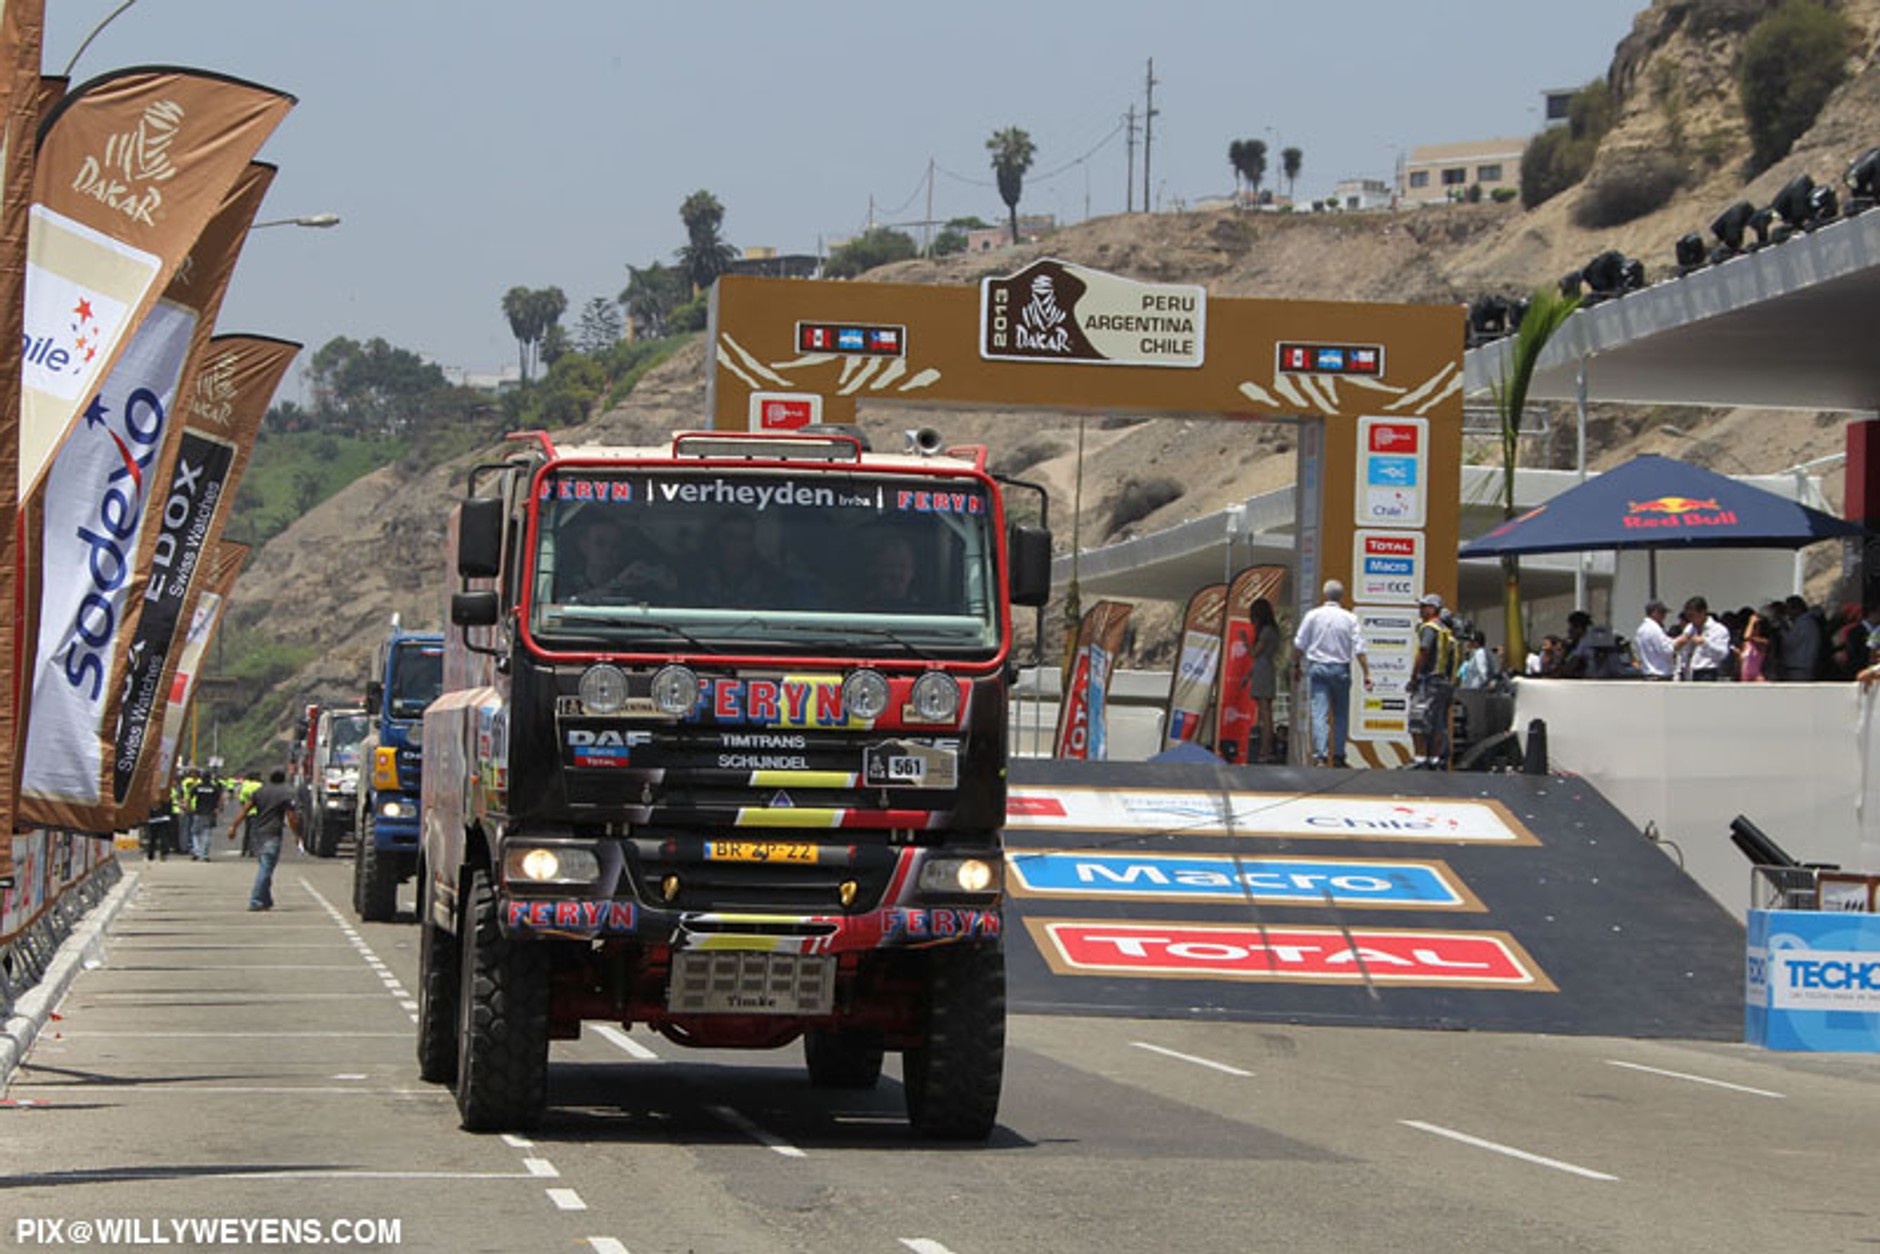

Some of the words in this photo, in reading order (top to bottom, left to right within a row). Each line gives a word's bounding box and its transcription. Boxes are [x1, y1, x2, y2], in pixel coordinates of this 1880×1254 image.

[72, 155, 162, 227] DAKAR
[993, 289, 1008, 347] 2013
[1142, 296, 1195, 312] PERU
[1015, 324, 1072, 352] DAKAR
[1085, 314, 1193, 333] ARGENTINA
[1140, 337, 1193, 355] CHILE
[660, 479, 834, 511] verheyden
[897, 490, 985, 515] FERYN
[145, 459, 204, 602] EDOX
[1622, 514, 1680, 529] Red
[1682, 511, 1738, 526] Bull
[65, 387, 164, 701] sodexo
[169, 551, 196, 598] Swiss
[186, 481, 220, 547] Watches
[1369, 540, 1411, 552] TOTAL
[130, 653, 163, 721] Watches
[567, 730, 653, 747] DAF
[720, 733, 806, 749] TIMTRANS
[718, 754, 810, 770] SCHIJNDEL
[895, 758, 921, 776] 561
[1305, 815, 1434, 833] Chile
[1074, 862, 1394, 894] Macro
[508, 901, 637, 934] FERYN
[880, 907, 1001, 937] FERYN
[1083, 935, 1491, 970] TOTAL
